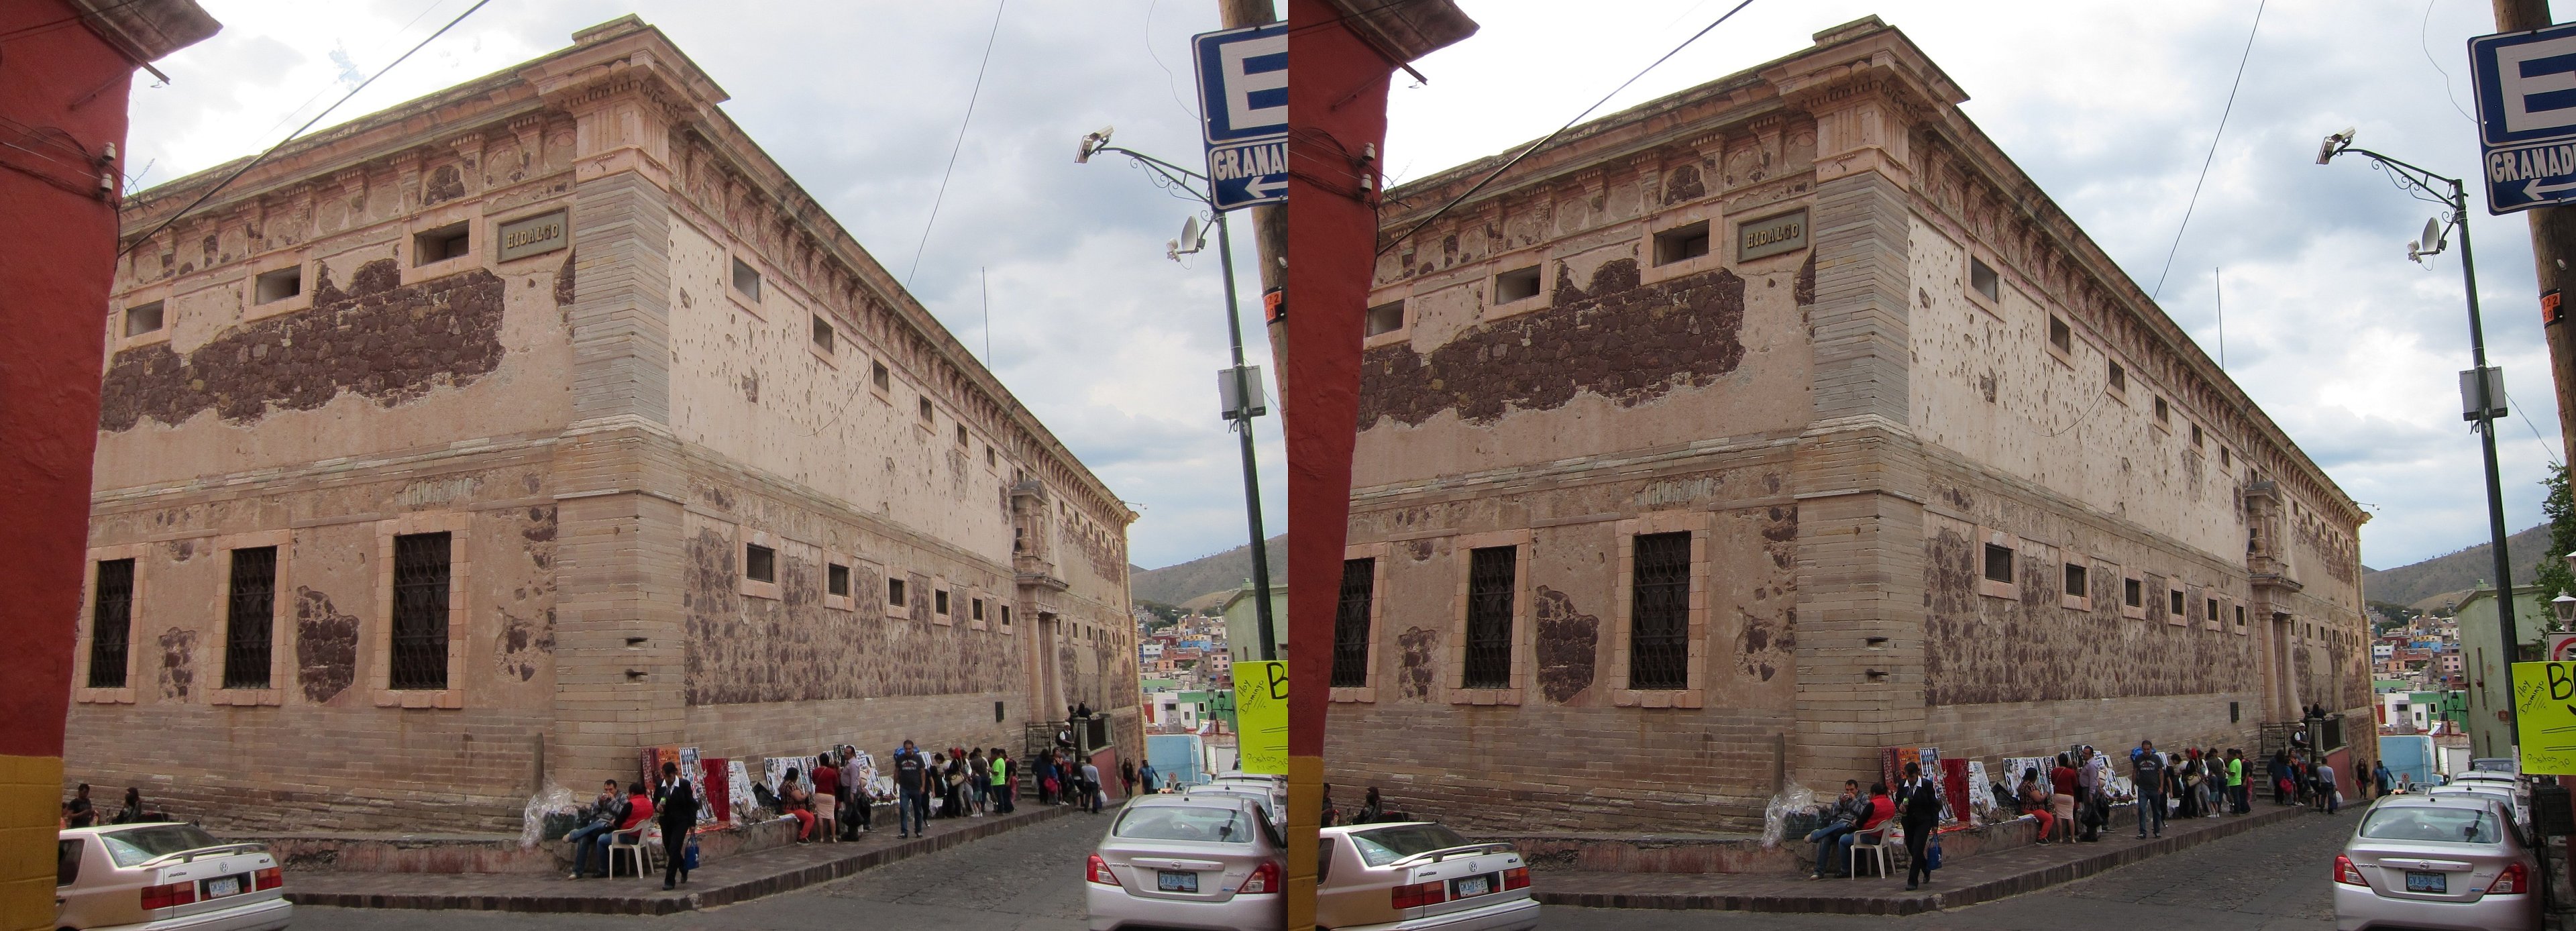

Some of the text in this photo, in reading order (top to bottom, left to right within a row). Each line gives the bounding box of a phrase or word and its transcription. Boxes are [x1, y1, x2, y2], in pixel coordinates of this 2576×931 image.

[1220, 34, 1288, 131] E
[2496, 36, 2576, 133] E
[507, 223, 559, 249] HIDALGO
[1747, 223, 1799, 248] HIDALGO
[1238, 679, 1252, 698] Hoy
[1239, 679, 1264, 714] Domingo
[1267, 662, 1288, 700] B
[2518, 680, 2531, 698] Hoy
[2518, 680, 2544, 715] Domingo
[2546, 663, 2576, 700] B
[2559, 758, 2570, 768] 70
